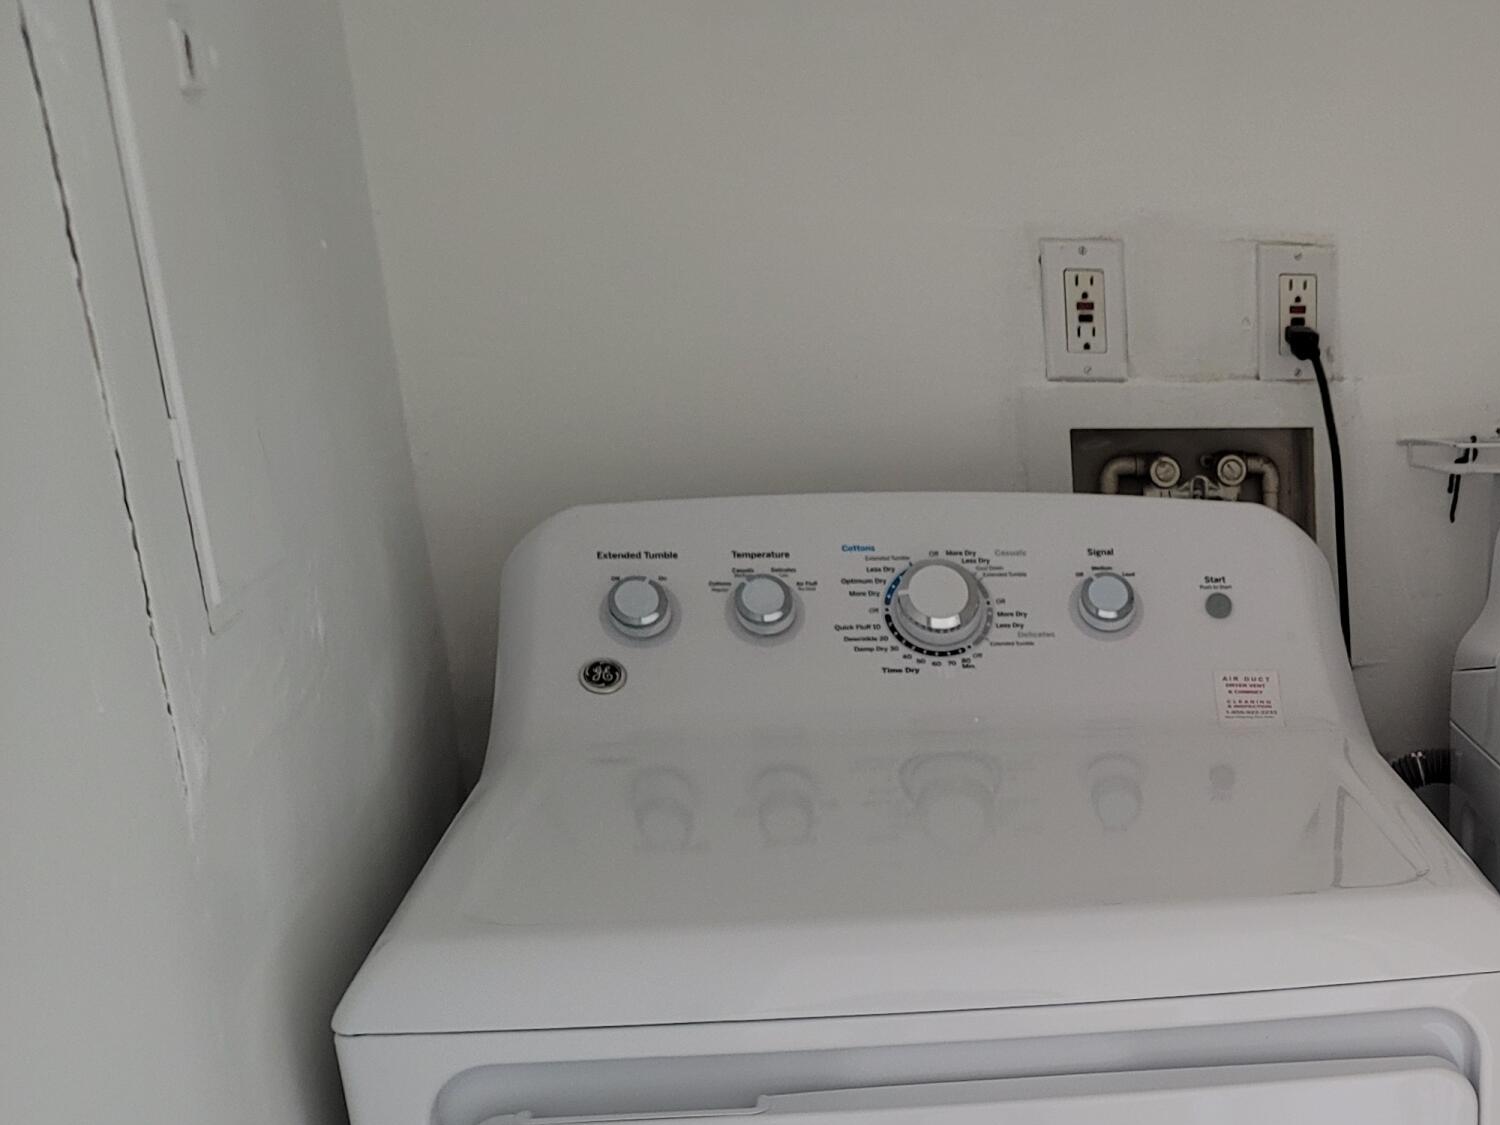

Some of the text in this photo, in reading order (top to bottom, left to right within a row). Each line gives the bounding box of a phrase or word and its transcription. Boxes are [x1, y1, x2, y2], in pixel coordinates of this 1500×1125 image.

[841, 544, 876, 552] Cottons
[1087, 547, 1114, 557] Signal
[596, 550, 679, 560] Extended Tumble
[731, 550, 790, 560] Temperature
[977, 557, 990, 565] Dry
[866, 566, 896, 574] Less Dry
[1204, 575, 1226, 583] Start
[867, 590, 880, 598] Dry
[1015, 610, 1028, 619] Dry
[834, 623, 854, 631] Quick
[1012, 622, 1025, 630] Dry
[881, 666, 920, 675] Time Dry
